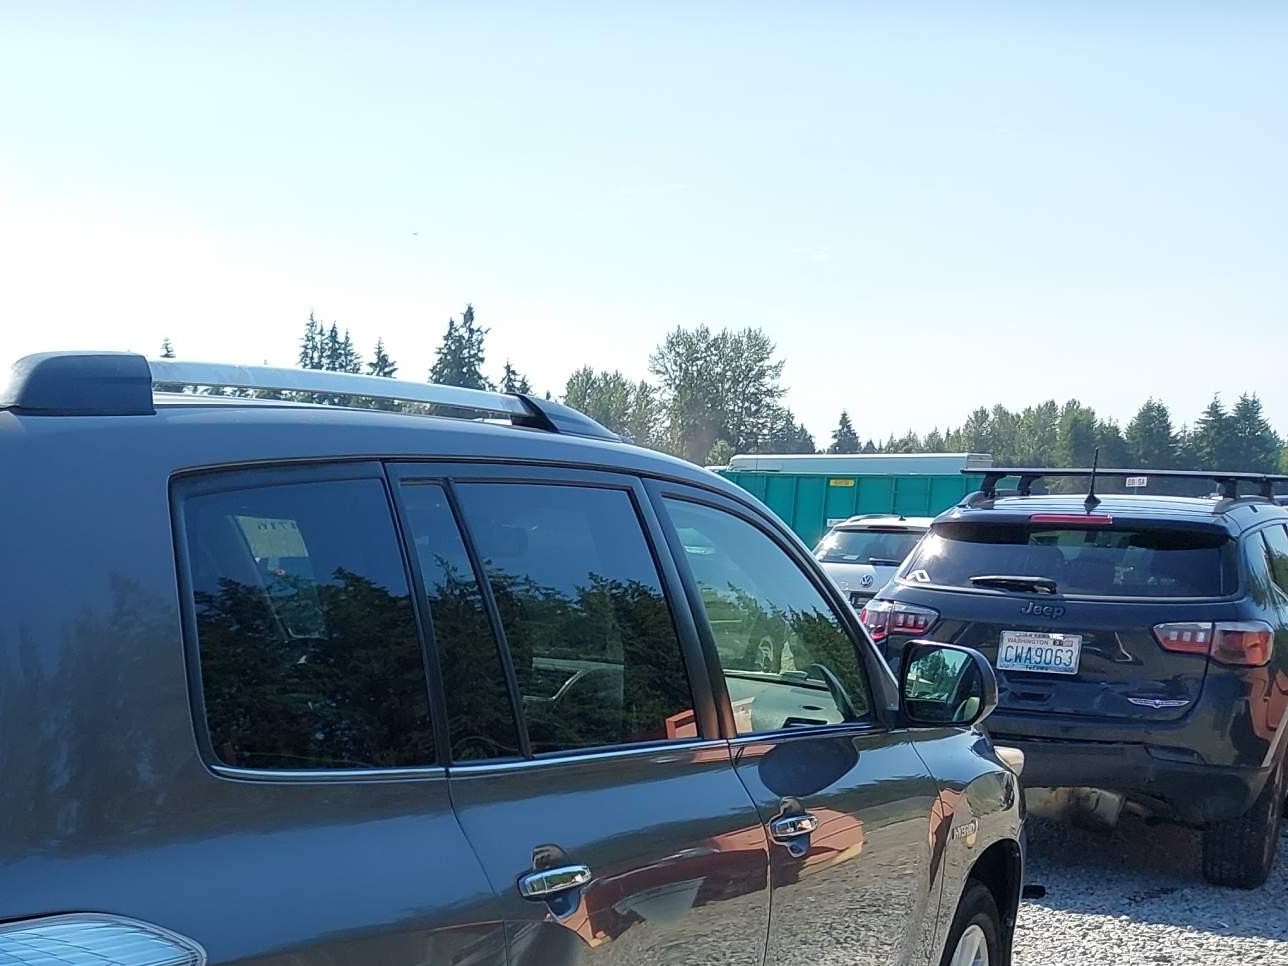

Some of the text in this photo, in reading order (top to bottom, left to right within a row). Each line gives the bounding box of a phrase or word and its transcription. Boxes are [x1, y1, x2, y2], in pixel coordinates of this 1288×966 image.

[1021, 601, 1065, 618] Jeep
[1007, 637, 1049, 646] WASHINGTON
[1004, 645, 1074, 667] CWA9063
